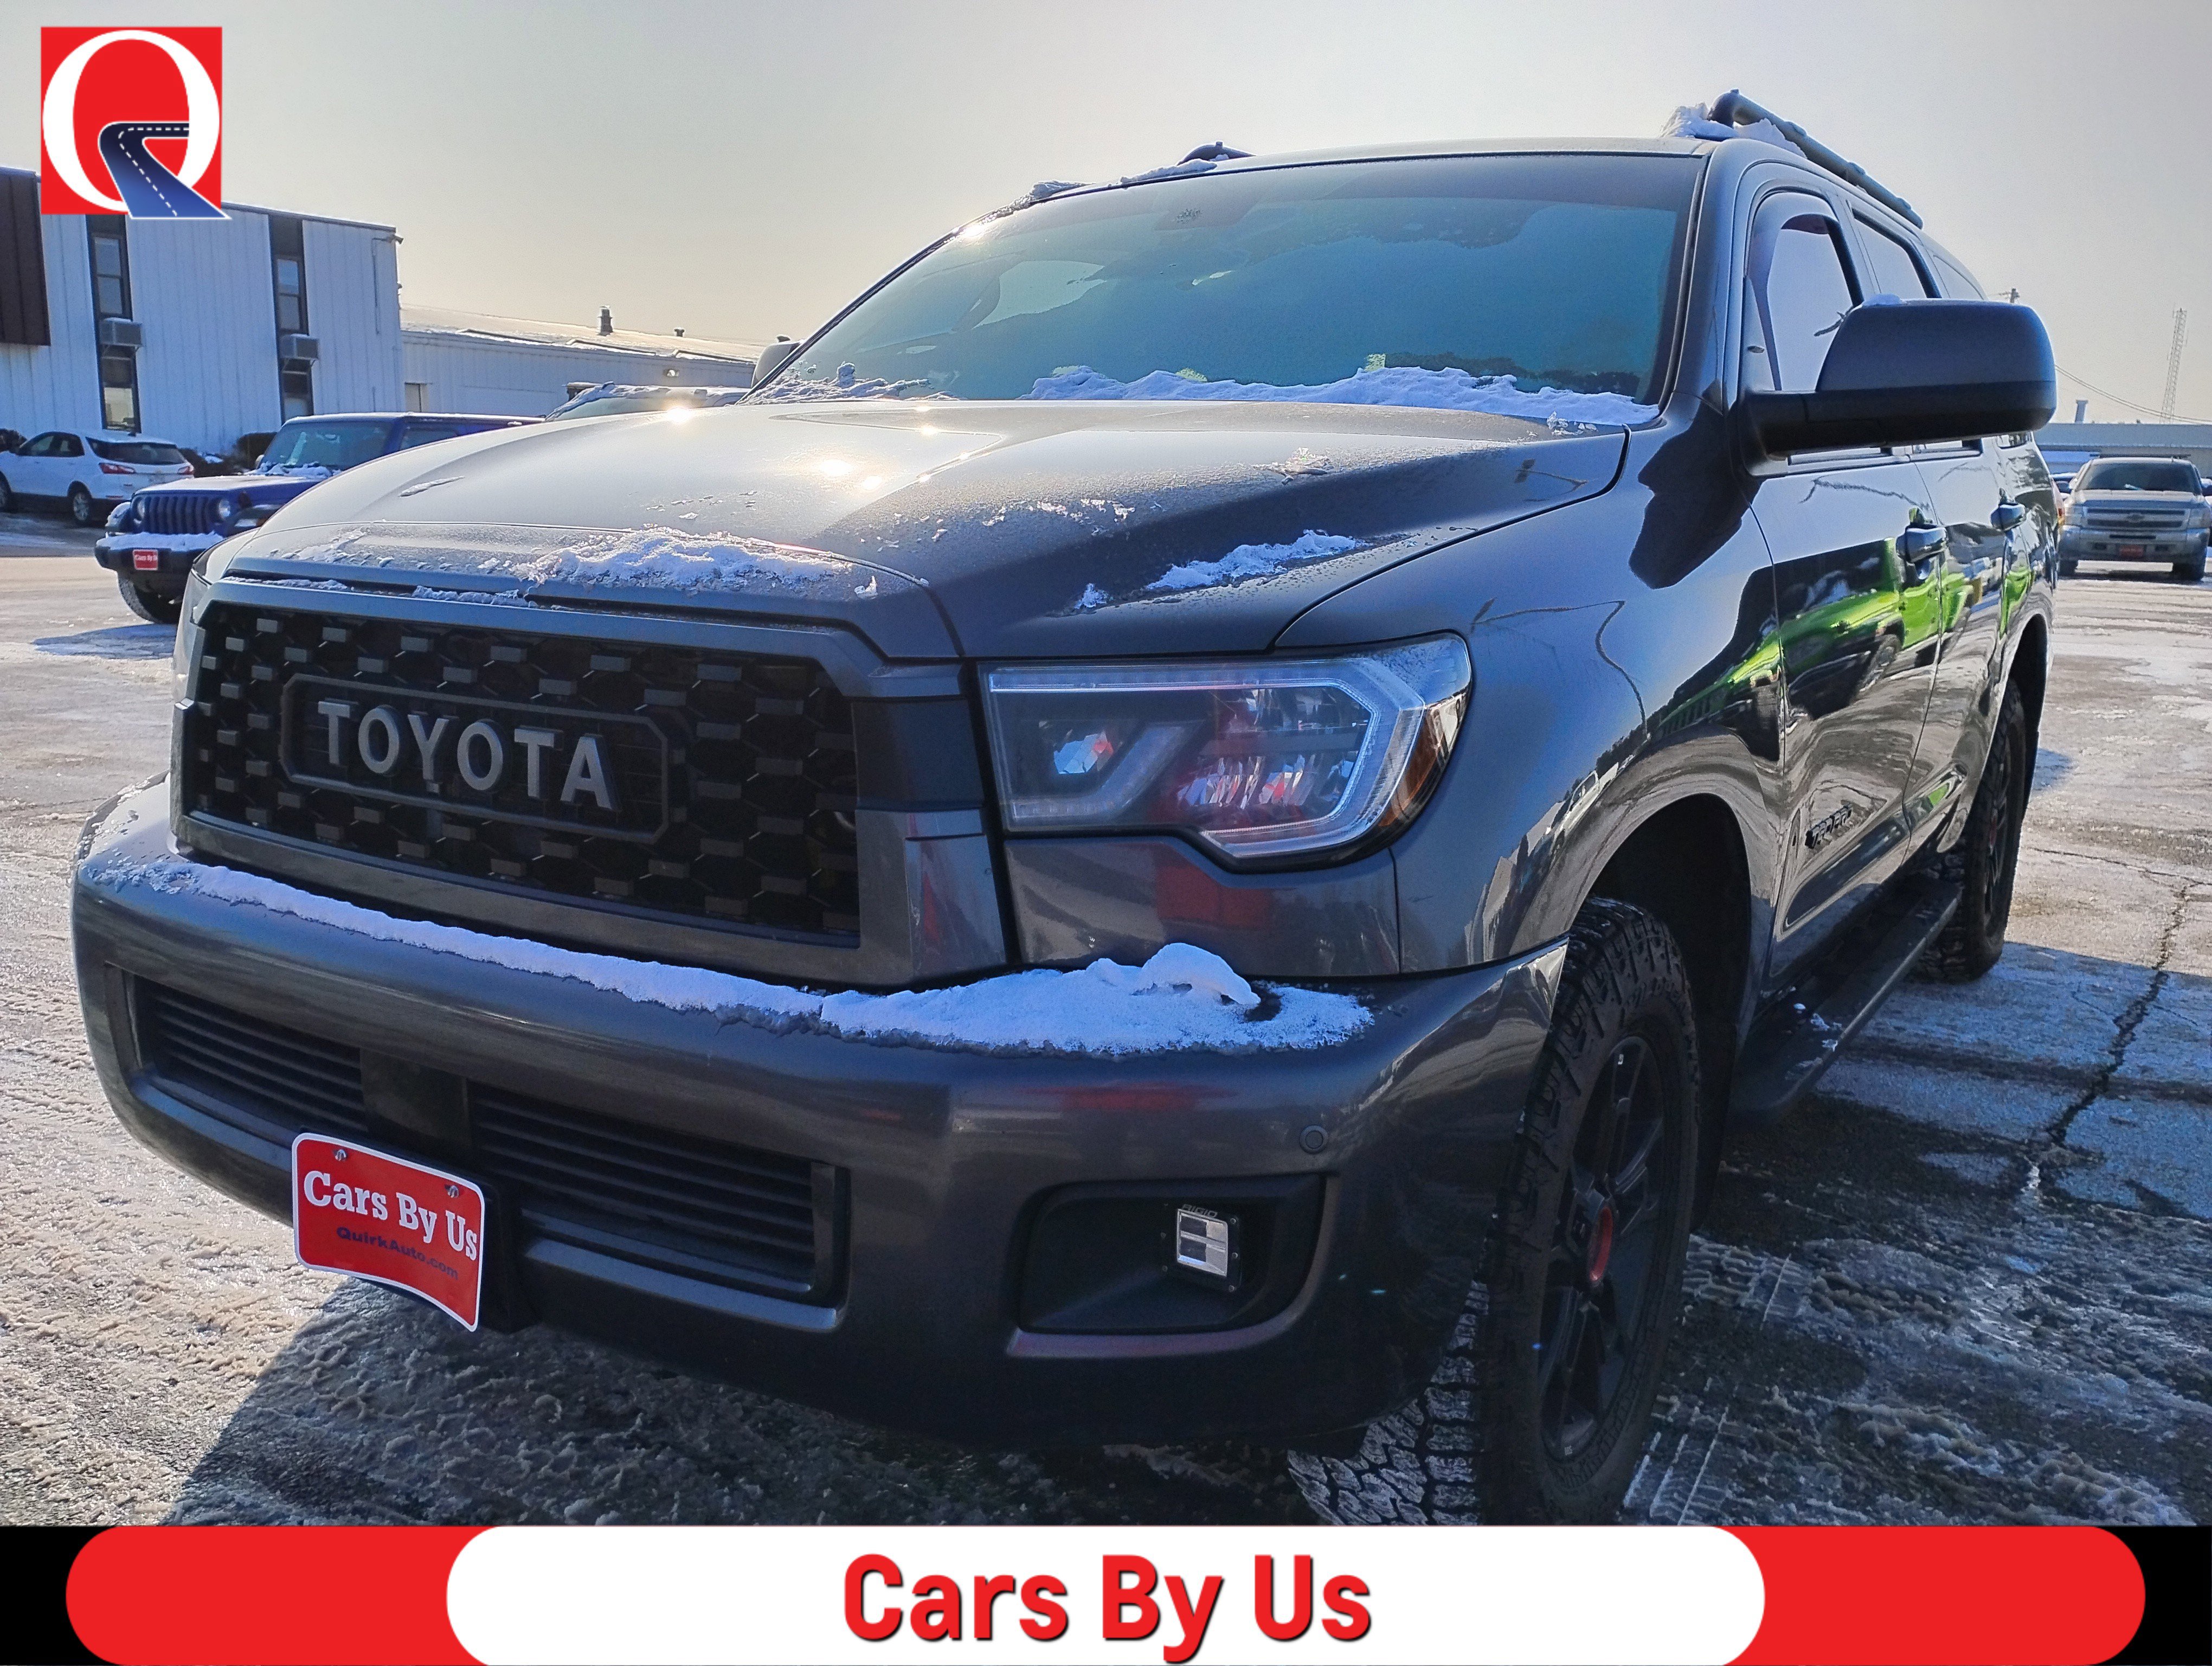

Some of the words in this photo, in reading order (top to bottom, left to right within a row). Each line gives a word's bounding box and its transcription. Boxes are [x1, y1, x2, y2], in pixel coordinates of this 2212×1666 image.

[318, 699, 620, 811] TOYOTA
[303, 1170, 389, 1221] Cars
[396, 1191, 438, 1244] By
[445, 1209, 477, 1261] Us
[336, 1226, 459, 1280] QuirkAuto.com
